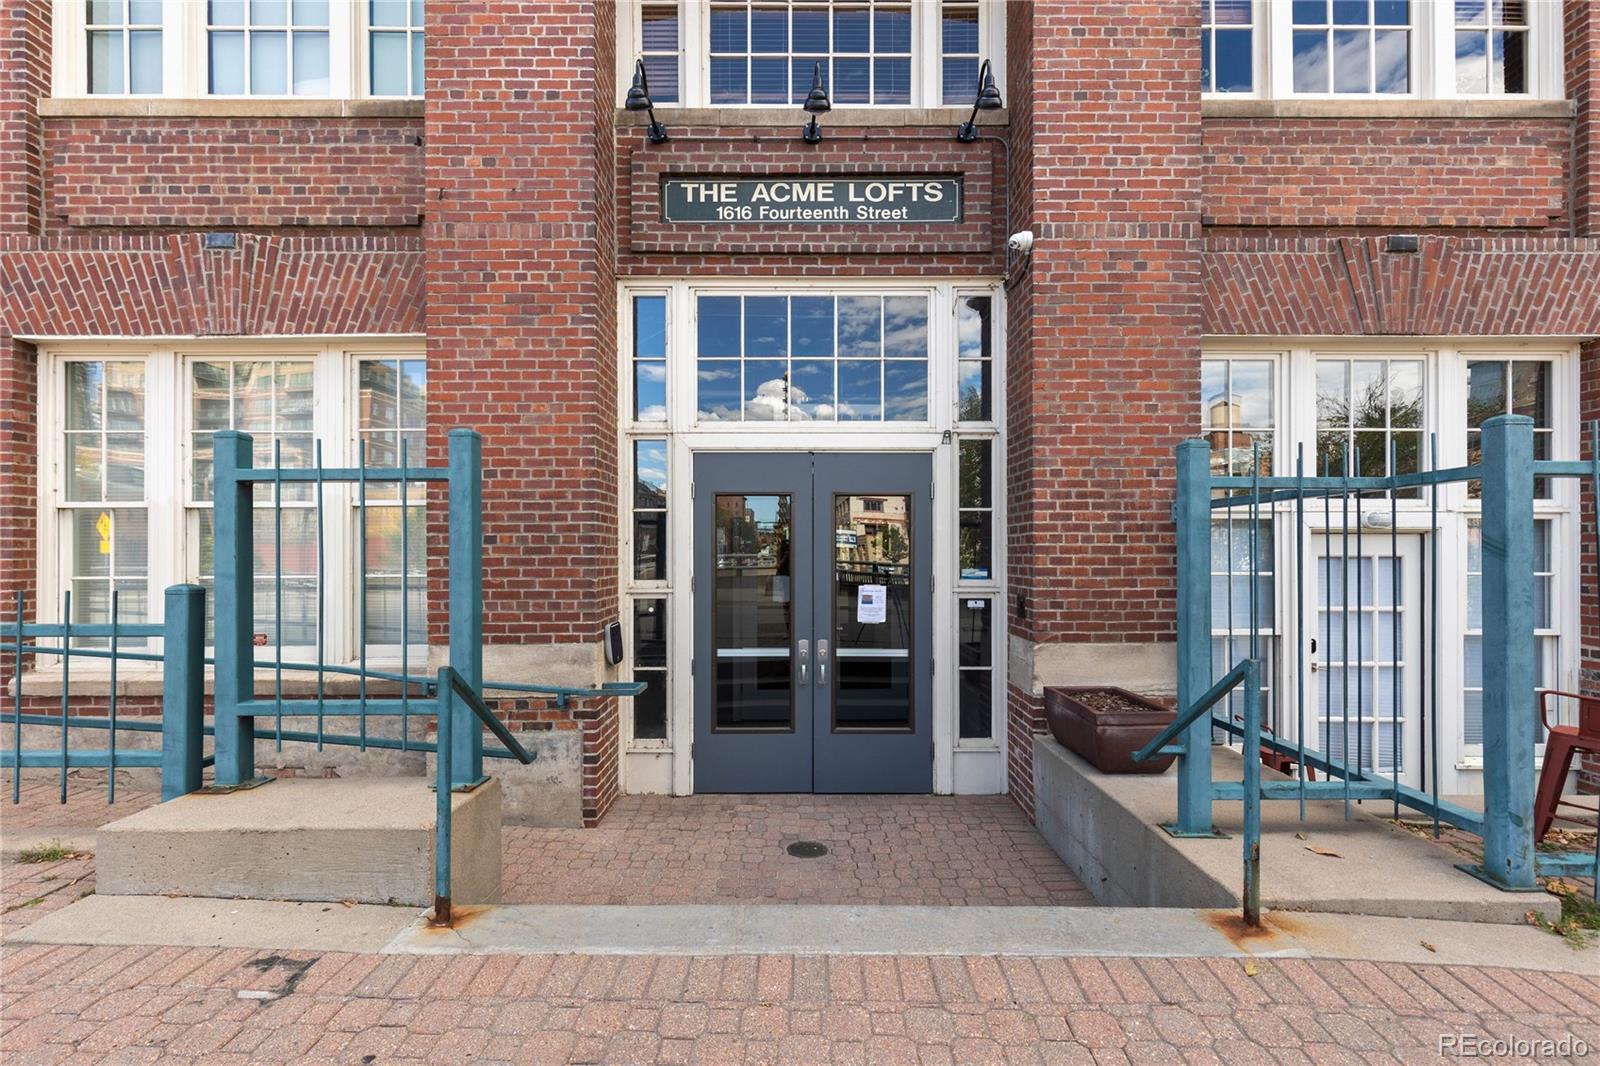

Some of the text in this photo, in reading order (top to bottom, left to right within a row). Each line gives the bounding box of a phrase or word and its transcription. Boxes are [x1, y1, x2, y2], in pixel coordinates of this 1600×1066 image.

[680, 182, 944, 203] THE ACME LOFTS
[716, 205, 908, 221] 1616 Fourteenth Street
